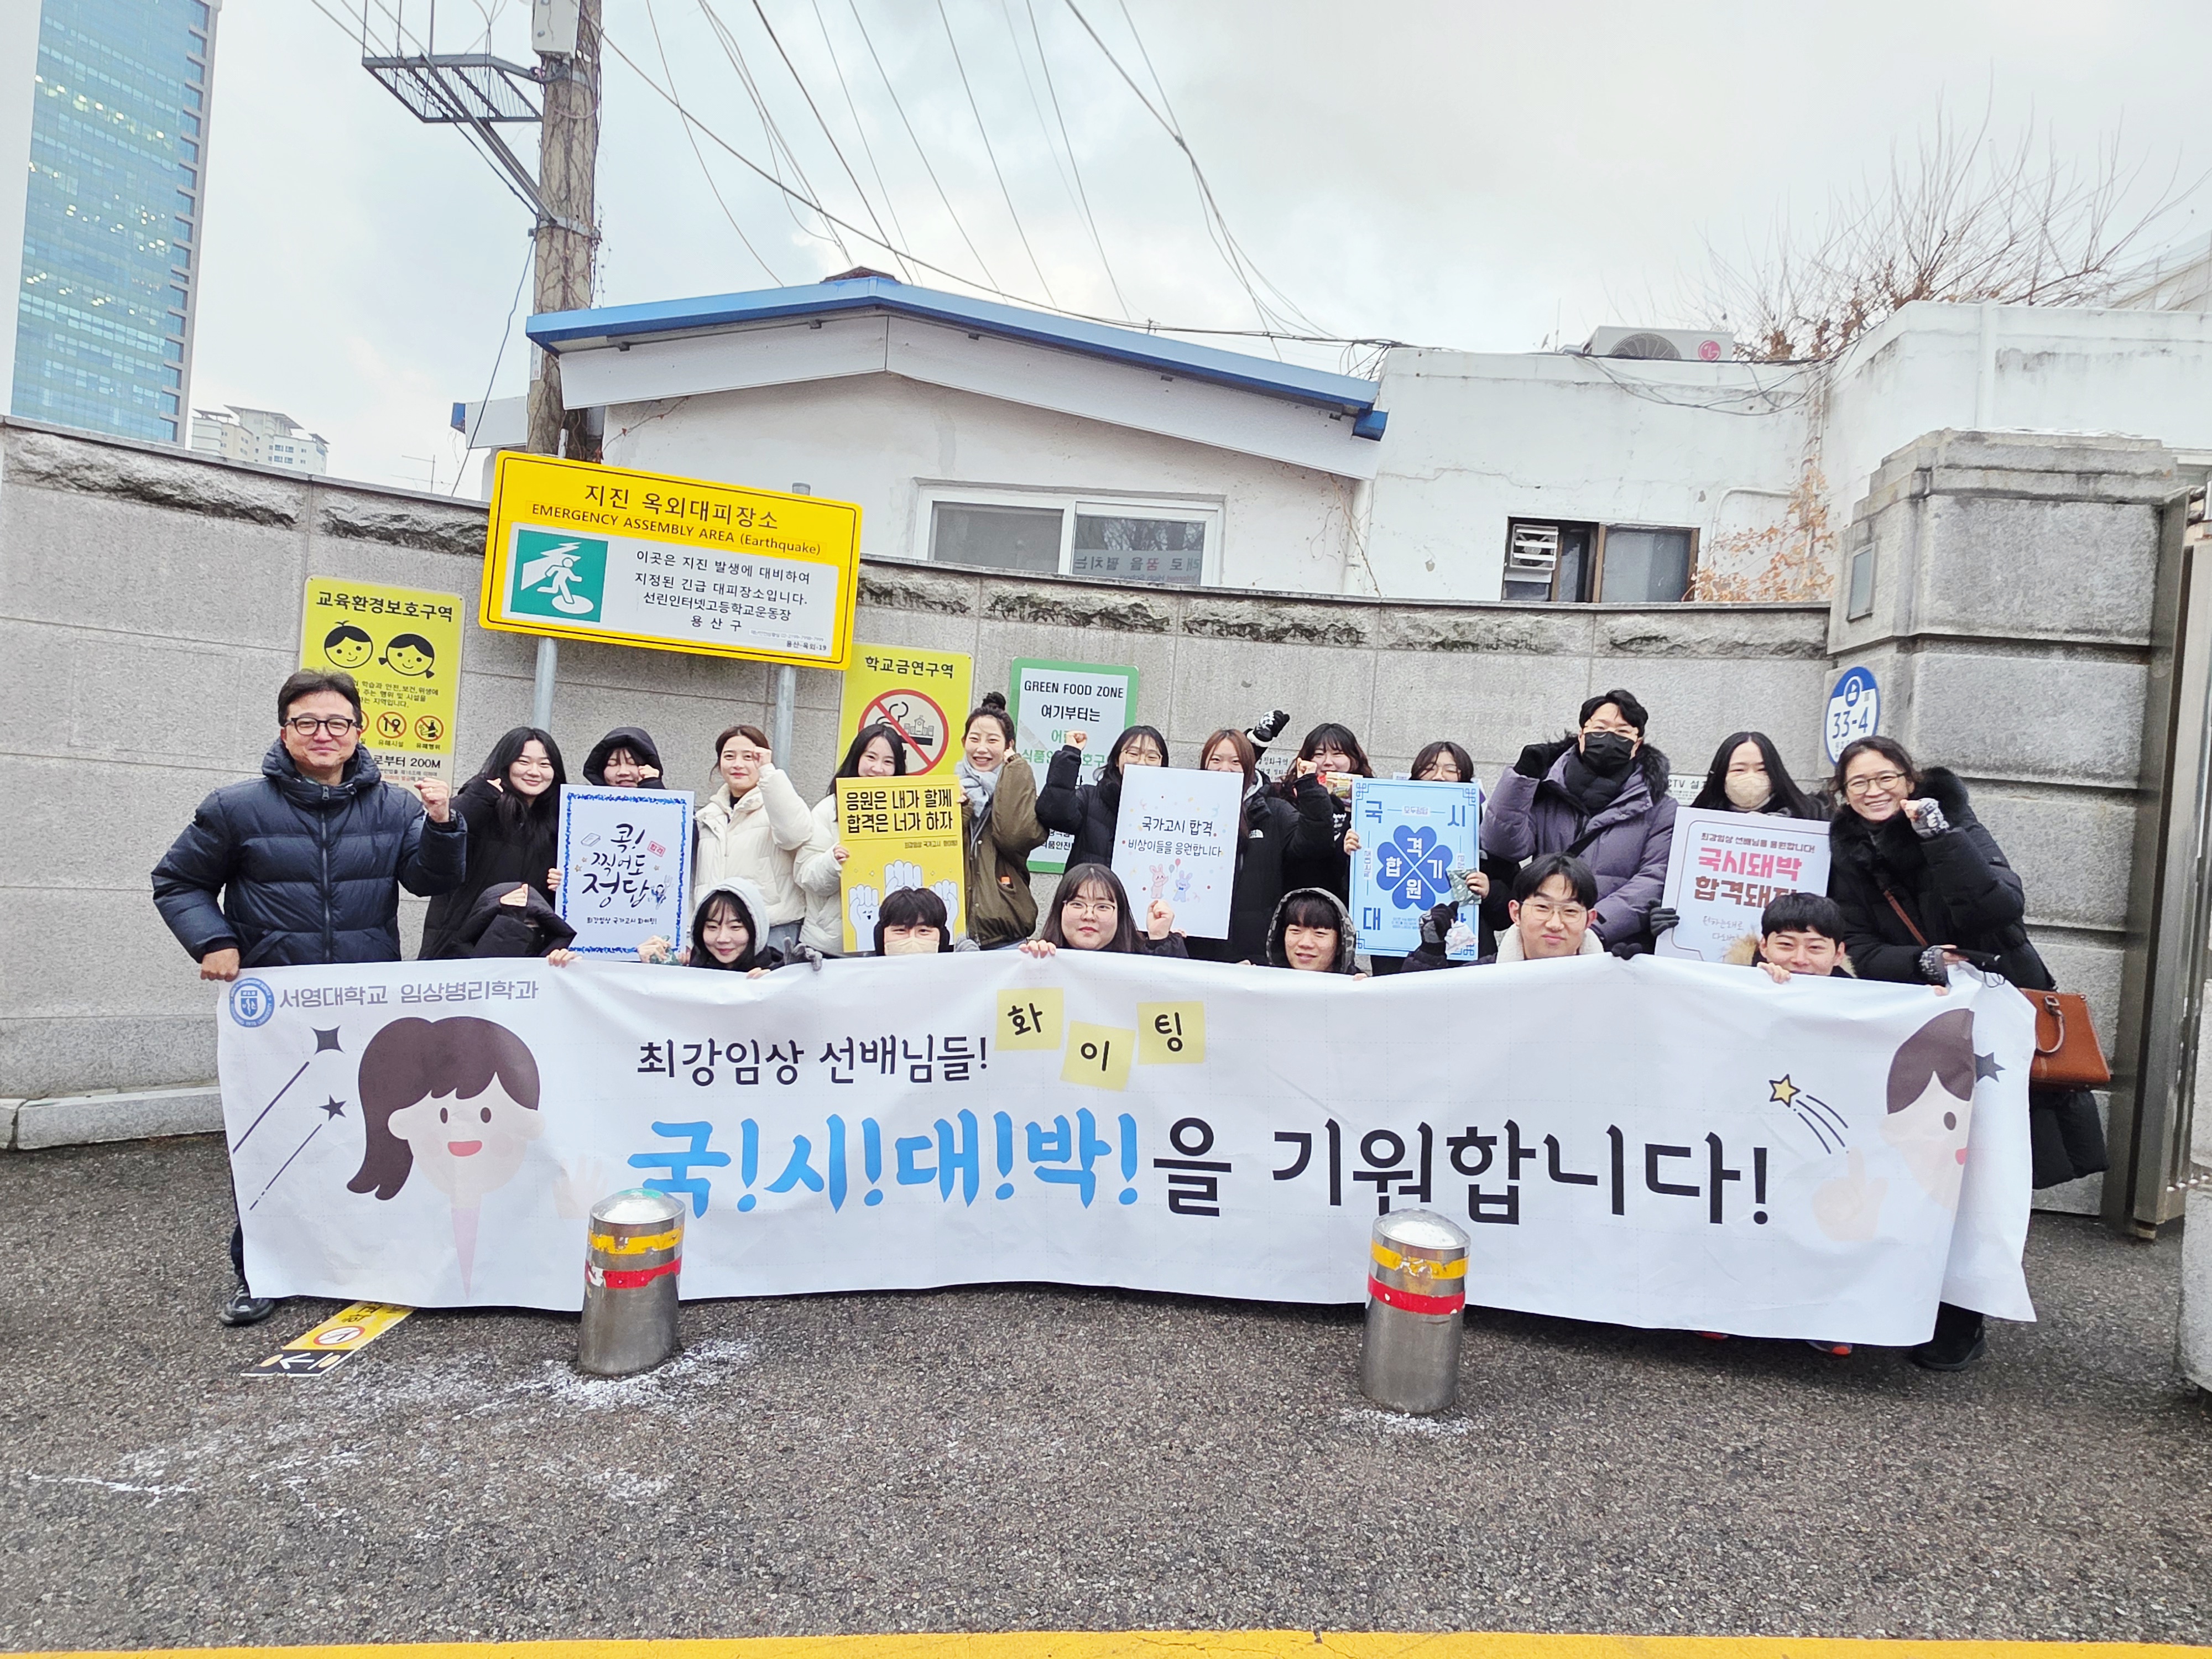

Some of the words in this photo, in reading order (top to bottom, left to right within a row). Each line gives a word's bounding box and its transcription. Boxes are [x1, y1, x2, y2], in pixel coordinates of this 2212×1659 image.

[585, 484, 629, 510] 지진
[641, 492, 778, 530] 옥외대피장소
[532, 504, 618, 527] EMERGENCY
[623, 517, 695, 538] ASSEMBLY
[698, 527, 734, 543] AREA
[740, 533, 821, 556] (Earthquake)
[637, 550, 676, 567] 이곳은
[682, 555, 708, 572] 지진
[714, 560, 753, 577] 발생에
[759, 565, 810, 585] 대비하여
[635, 572, 675, 588] 지정된
[681, 576, 706, 593] 긴급
[713, 581, 808, 606] 대피장소입니다.
[316, 591, 453, 623] 교육환경보호구역
[643, 592, 791, 622] 선린인터넷고등학교운동장
[690, 615, 703, 628] 용
[710, 618, 722, 630] 산
[729, 621, 743, 633] 구
[865, 656, 954, 679] 학교금연구역
[1024, 680, 1059, 693] GREEN
[1063, 684, 1092, 696] FOOD
[1097, 686, 1124, 698] ZONE
[1041, 703, 1100, 722] 여기부터는
[1832, 707, 1869, 739] 33-4
[410, 758, 441, 769] 200M
[846, 791, 888, 811] 응원은
[892, 790, 920, 809] 내가
[924, 789, 952, 807] 할께
[1365, 800, 1383, 823] 국
[847, 814, 889, 833] 합격은
[894, 812, 921, 831] 너가
[926, 811, 953, 830] 하자
[1142, 816, 1185, 833] 국가고시
[1190, 820, 1213, 837] 합격
[1447, 805, 1465, 827] 시
[611, 823, 645, 853] 콕!
[1128, 839, 1172, 854] 비상이들을
[1175, 842, 1222, 857] 응원합니다
[591, 853, 646, 877] 찍어도
[1698, 847, 1802, 881] 국시돼박
[582, 872, 650, 908] 정답
[1363, 907, 1381, 931] 대
[279, 986, 388, 1009] 서영대학교
[400, 980, 539, 1004] 임상병리학과
[1007, 1003, 1043, 1036] 화
[1079, 1040, 1109, 1072] 이
[1154, 1013, 1184, 1052] 팅
[637, 1039, 805, 1087] 최강임상
[820, 1034, 989, 1086] 선배님들!
[1271, 1118, 1769, 1225] 기원합니다!
